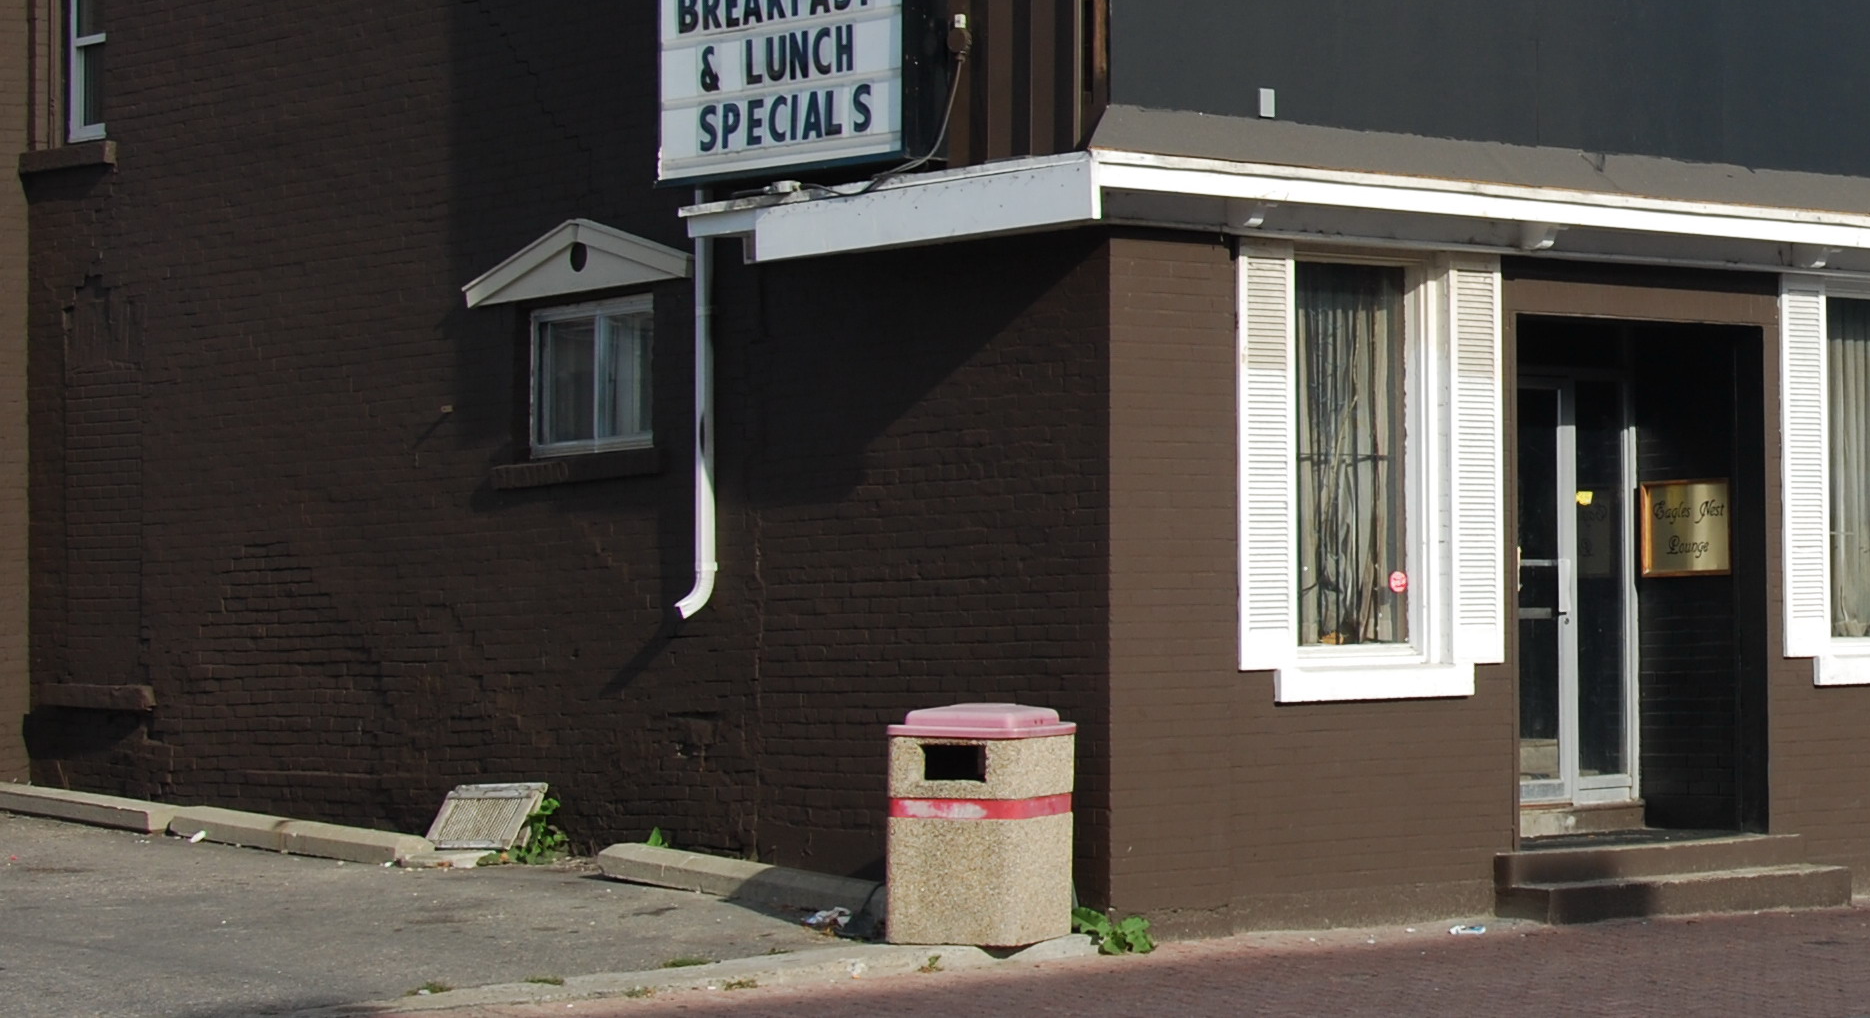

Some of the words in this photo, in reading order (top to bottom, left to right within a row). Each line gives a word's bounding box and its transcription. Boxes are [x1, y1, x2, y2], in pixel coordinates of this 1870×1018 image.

[700, 46, 721, 92] &
[745, 24, 854, 85] LUNCH
[700, 84, 873, 152] SPECIALS
[1653, 499, 1692, 525] Eagles
[1695, 499, 1726, 524] Nest
[1666, 535, 1710, 558] Lounge
